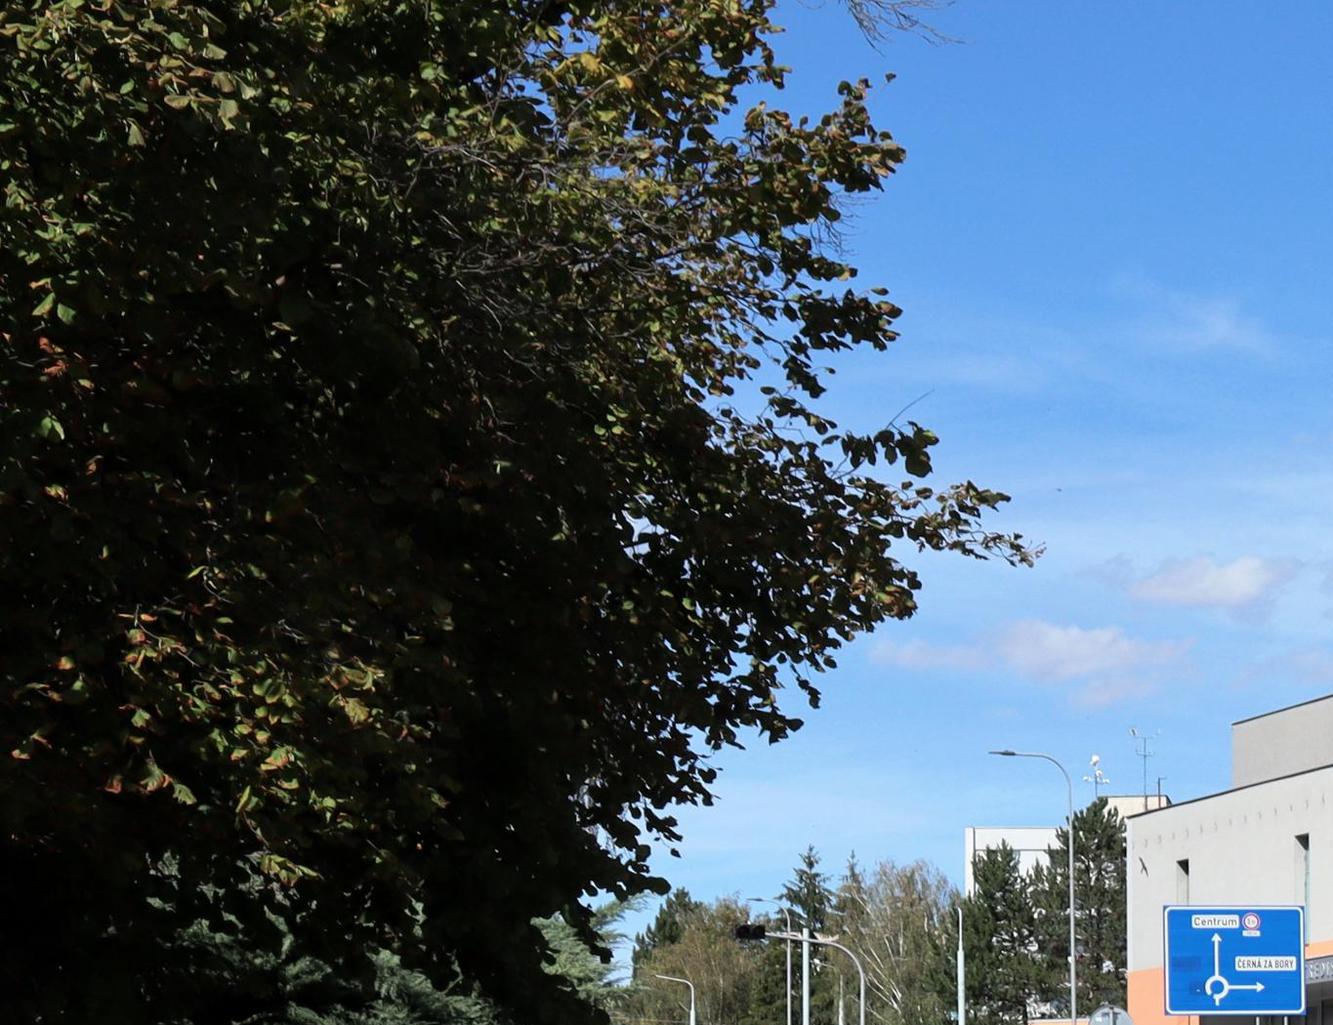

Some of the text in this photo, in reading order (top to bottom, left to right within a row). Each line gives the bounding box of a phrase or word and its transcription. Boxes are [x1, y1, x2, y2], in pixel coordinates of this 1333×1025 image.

[1194, 917, 1237, 926] Centrum
[1237, 958, 1294, 969] ČERNÁ ZA BORY
